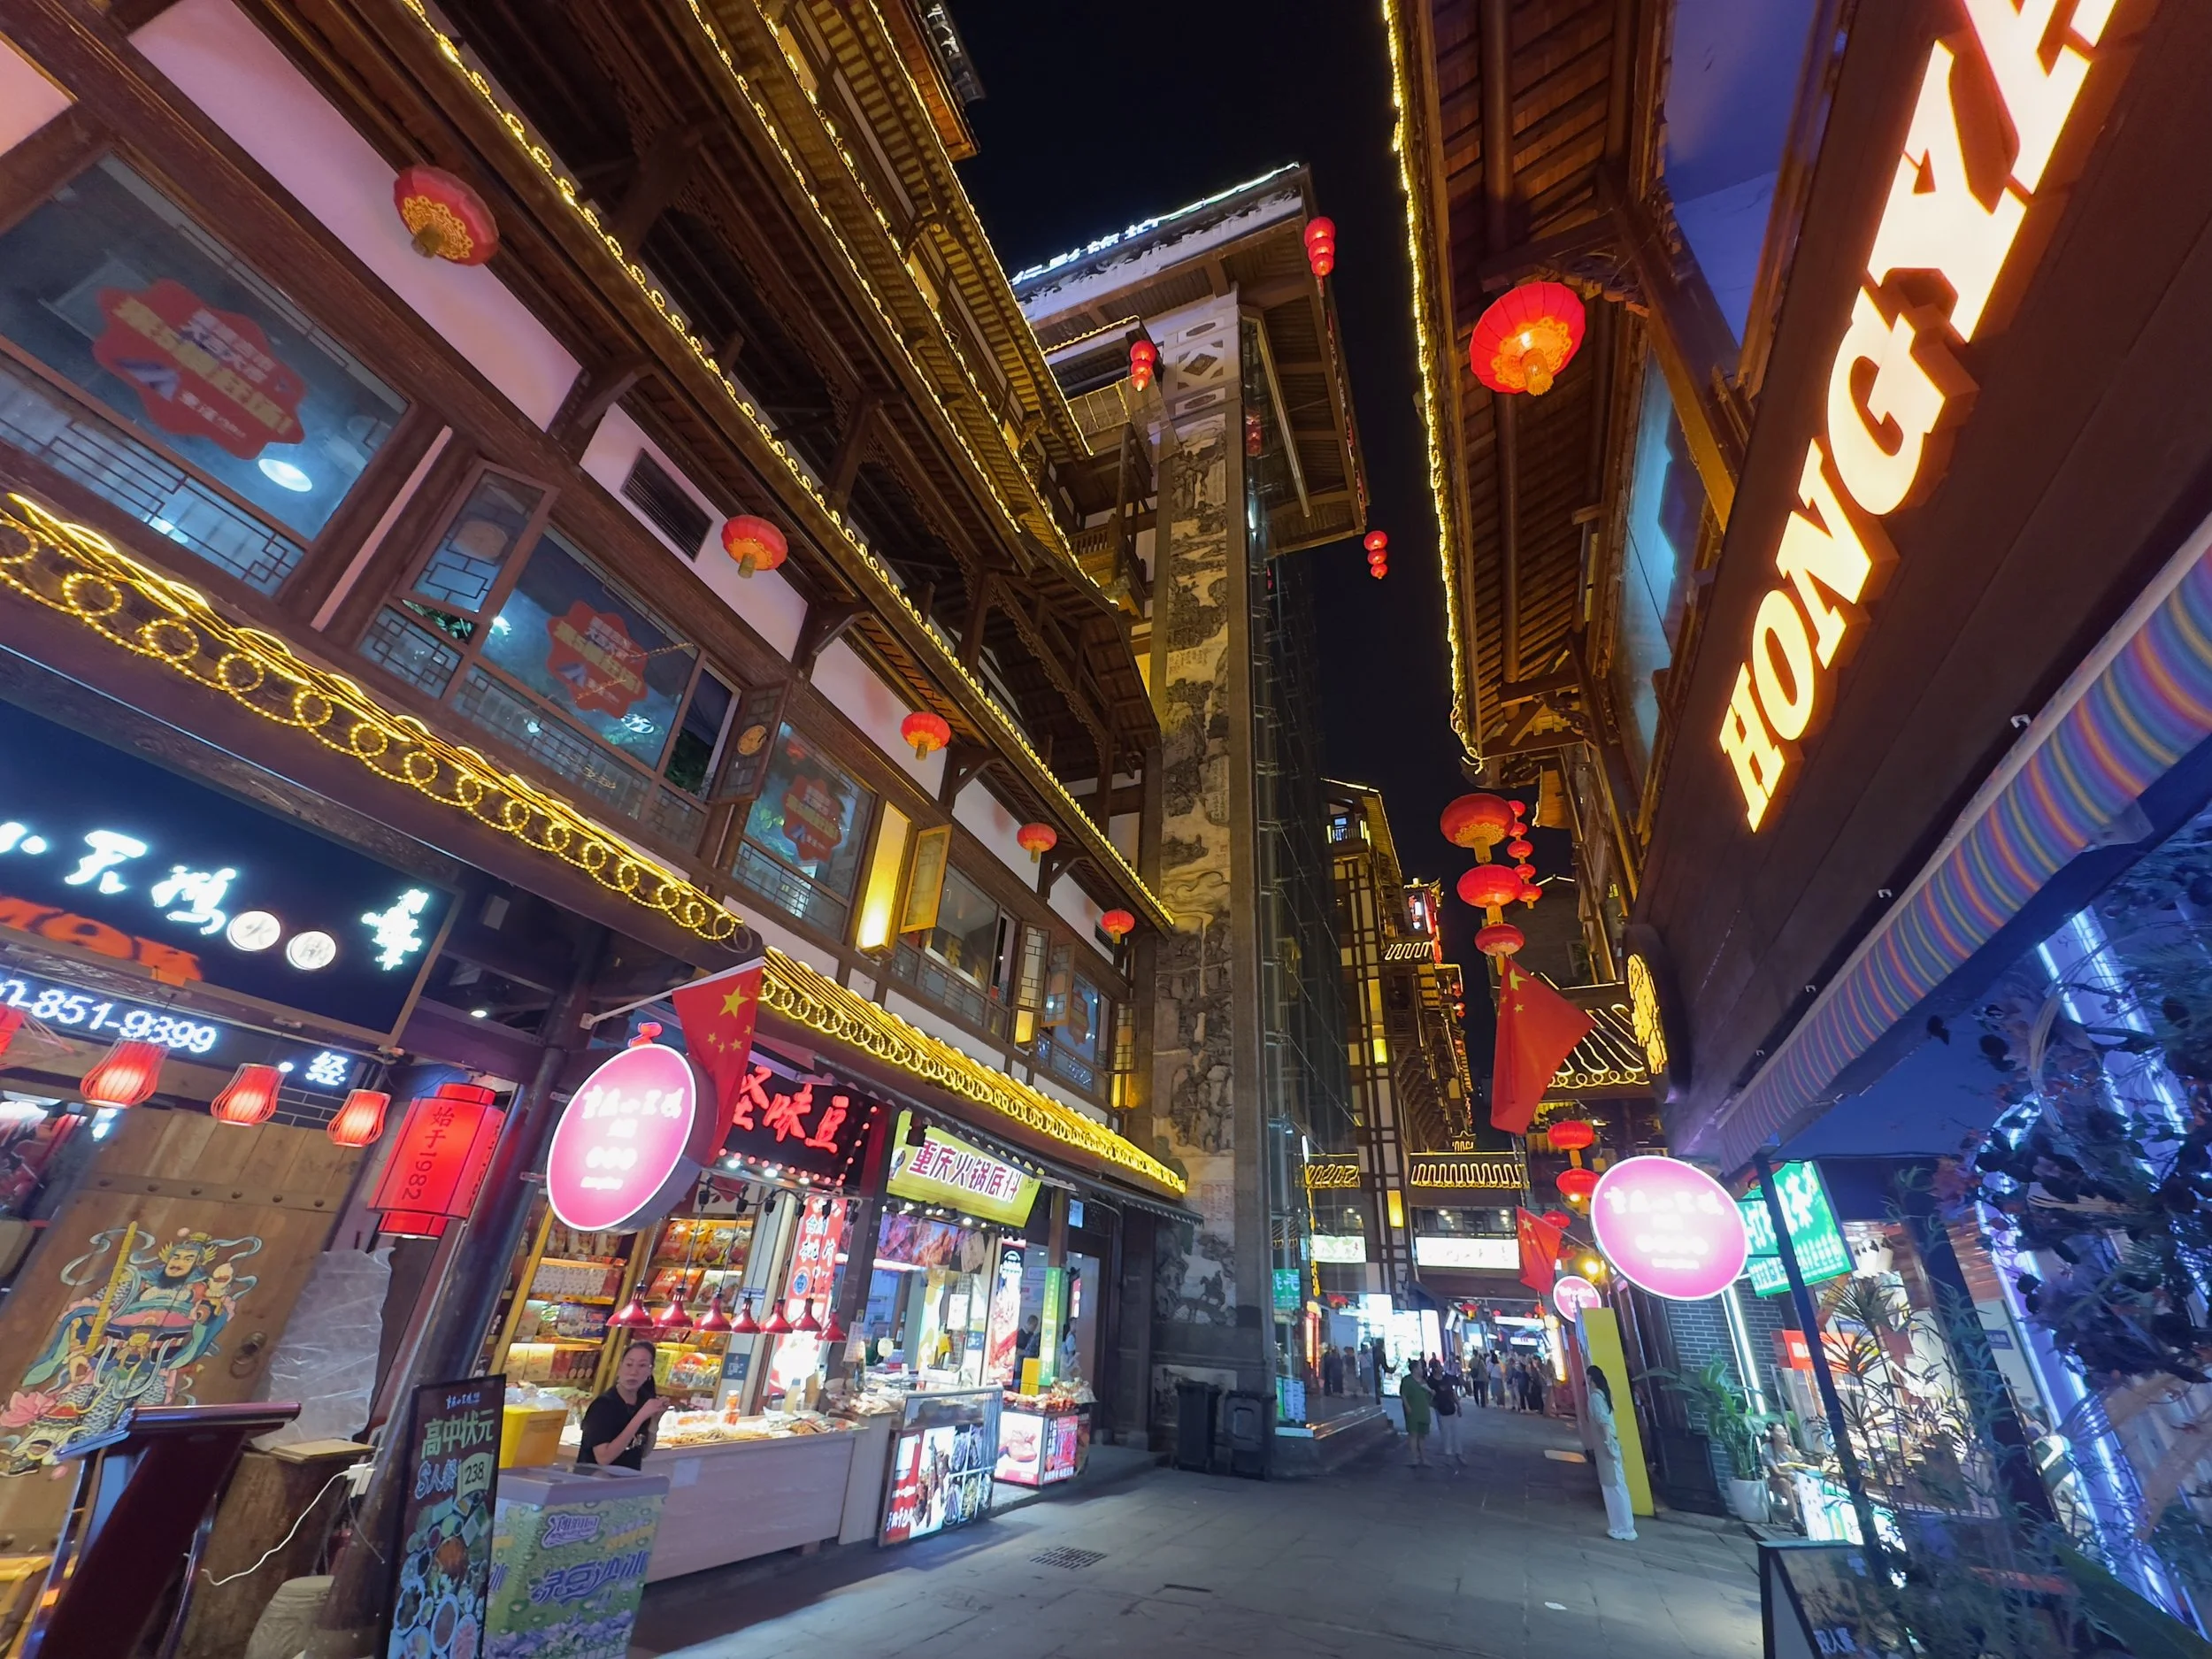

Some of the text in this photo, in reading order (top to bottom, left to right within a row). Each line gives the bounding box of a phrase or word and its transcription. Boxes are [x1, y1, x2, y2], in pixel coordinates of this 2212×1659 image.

[421, 1409, 495, 1460] 高中状元
[465, 1462, 485, 1486] 238
